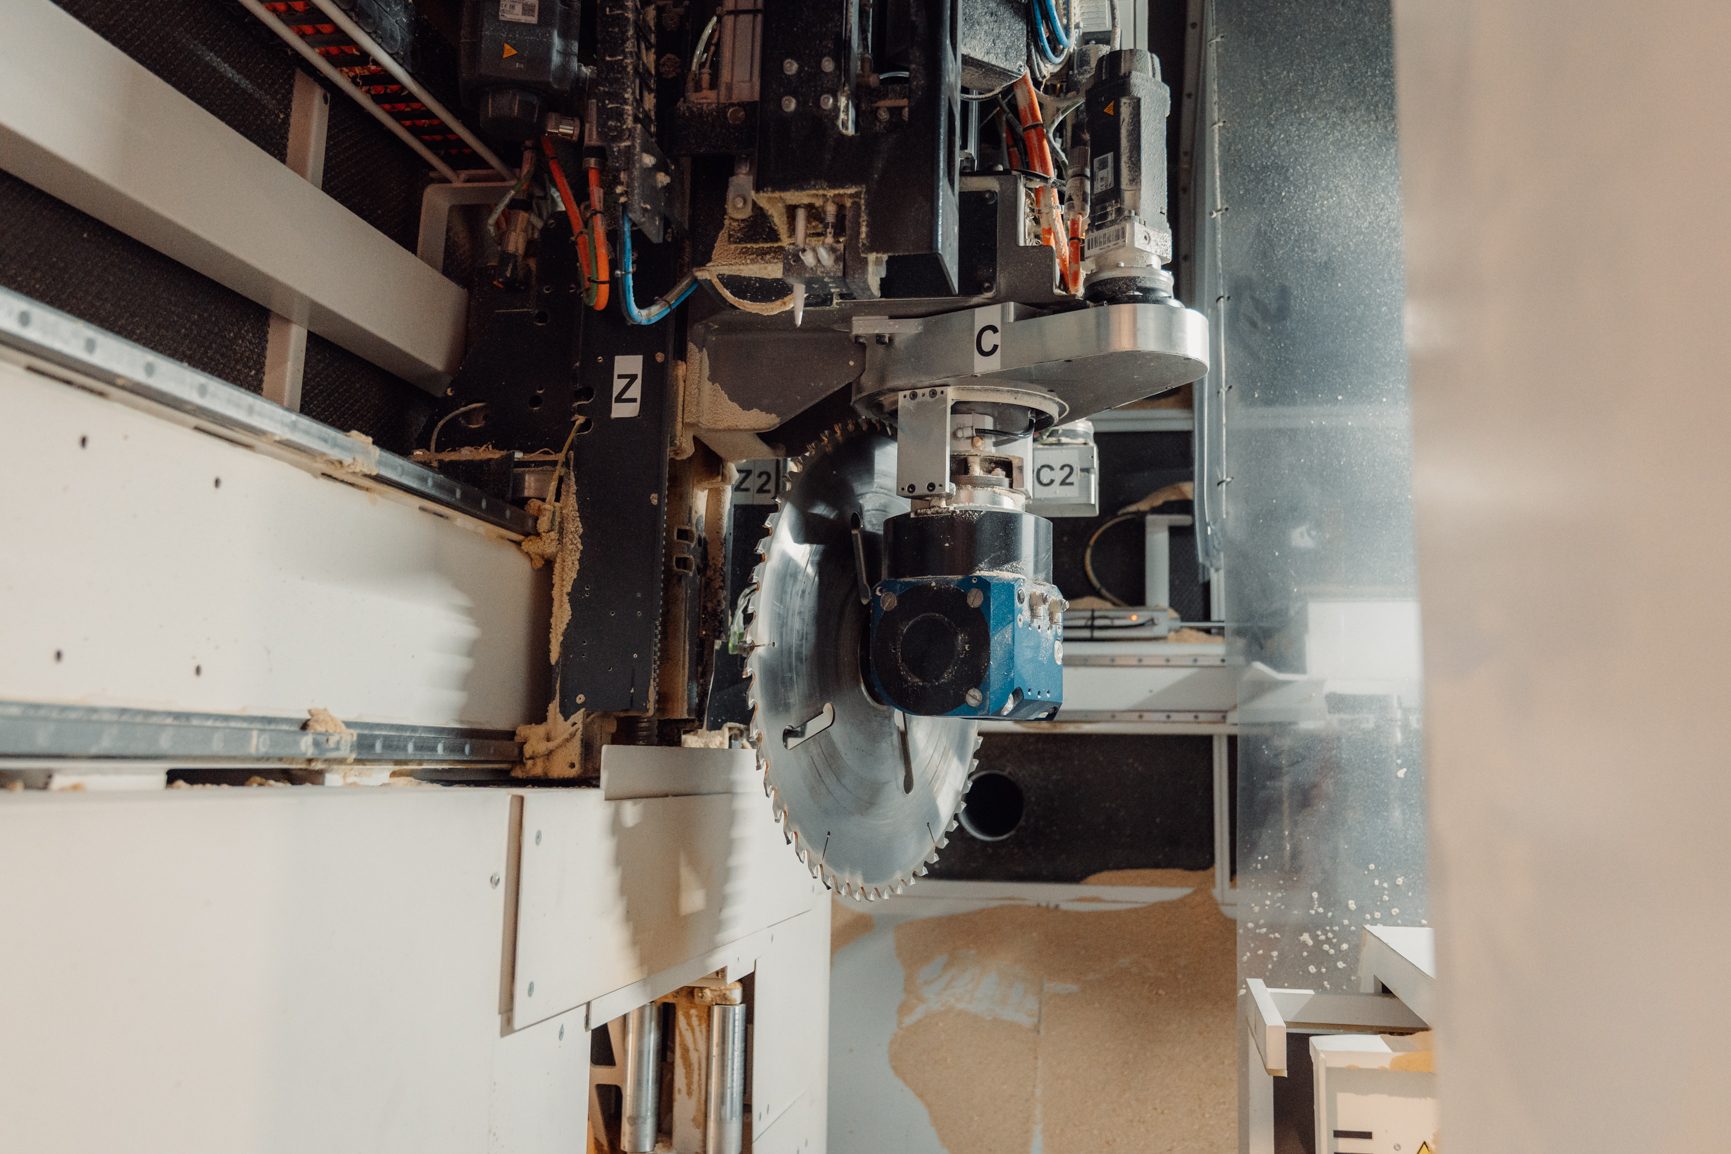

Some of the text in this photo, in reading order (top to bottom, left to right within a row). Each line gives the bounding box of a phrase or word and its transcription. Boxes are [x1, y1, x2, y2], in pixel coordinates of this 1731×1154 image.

[976, 325, 999, 357] C
[614, 374, 638, 403] Z
[734, 469, 771, 494] Z2
[1036, 464, 1074, 487] C2
